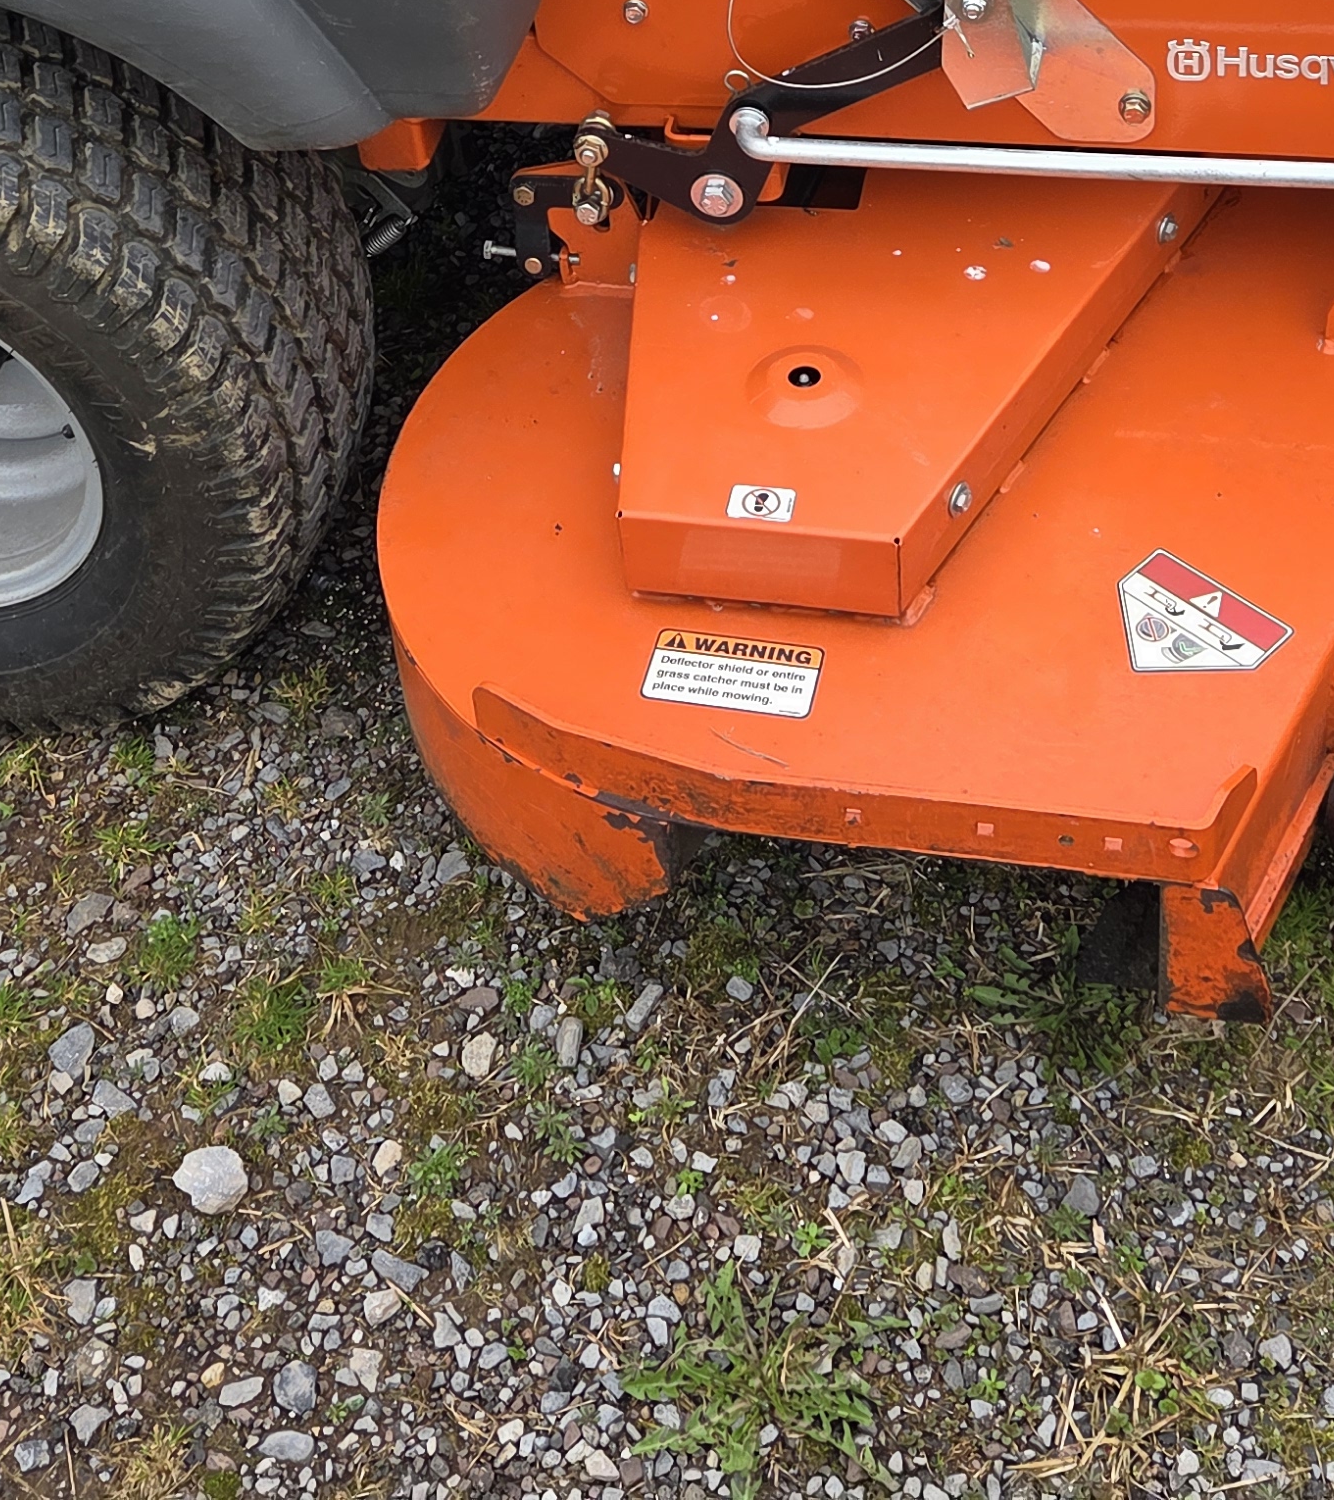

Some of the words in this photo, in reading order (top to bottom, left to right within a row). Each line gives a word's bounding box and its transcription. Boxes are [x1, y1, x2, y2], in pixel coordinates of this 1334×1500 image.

[694, 637, 813, 665] WARNING
[661, 655, 715, 670] Deflector
[718, 663, 754, 675] shield
[756, 668, 769, 677] or
[772, 670, 806, 682] entire
[652, 681, 685, 693] place
[688, 686, 719, 697] while
[722, 690, 773, 706] mowing.
[656, 669, 690, 680] grass
[693, 672, 736, 686] catcher
[740, 678, 771, 690] must
[774, 683, 788, 693] be
[791, 685, 803, 695] in
